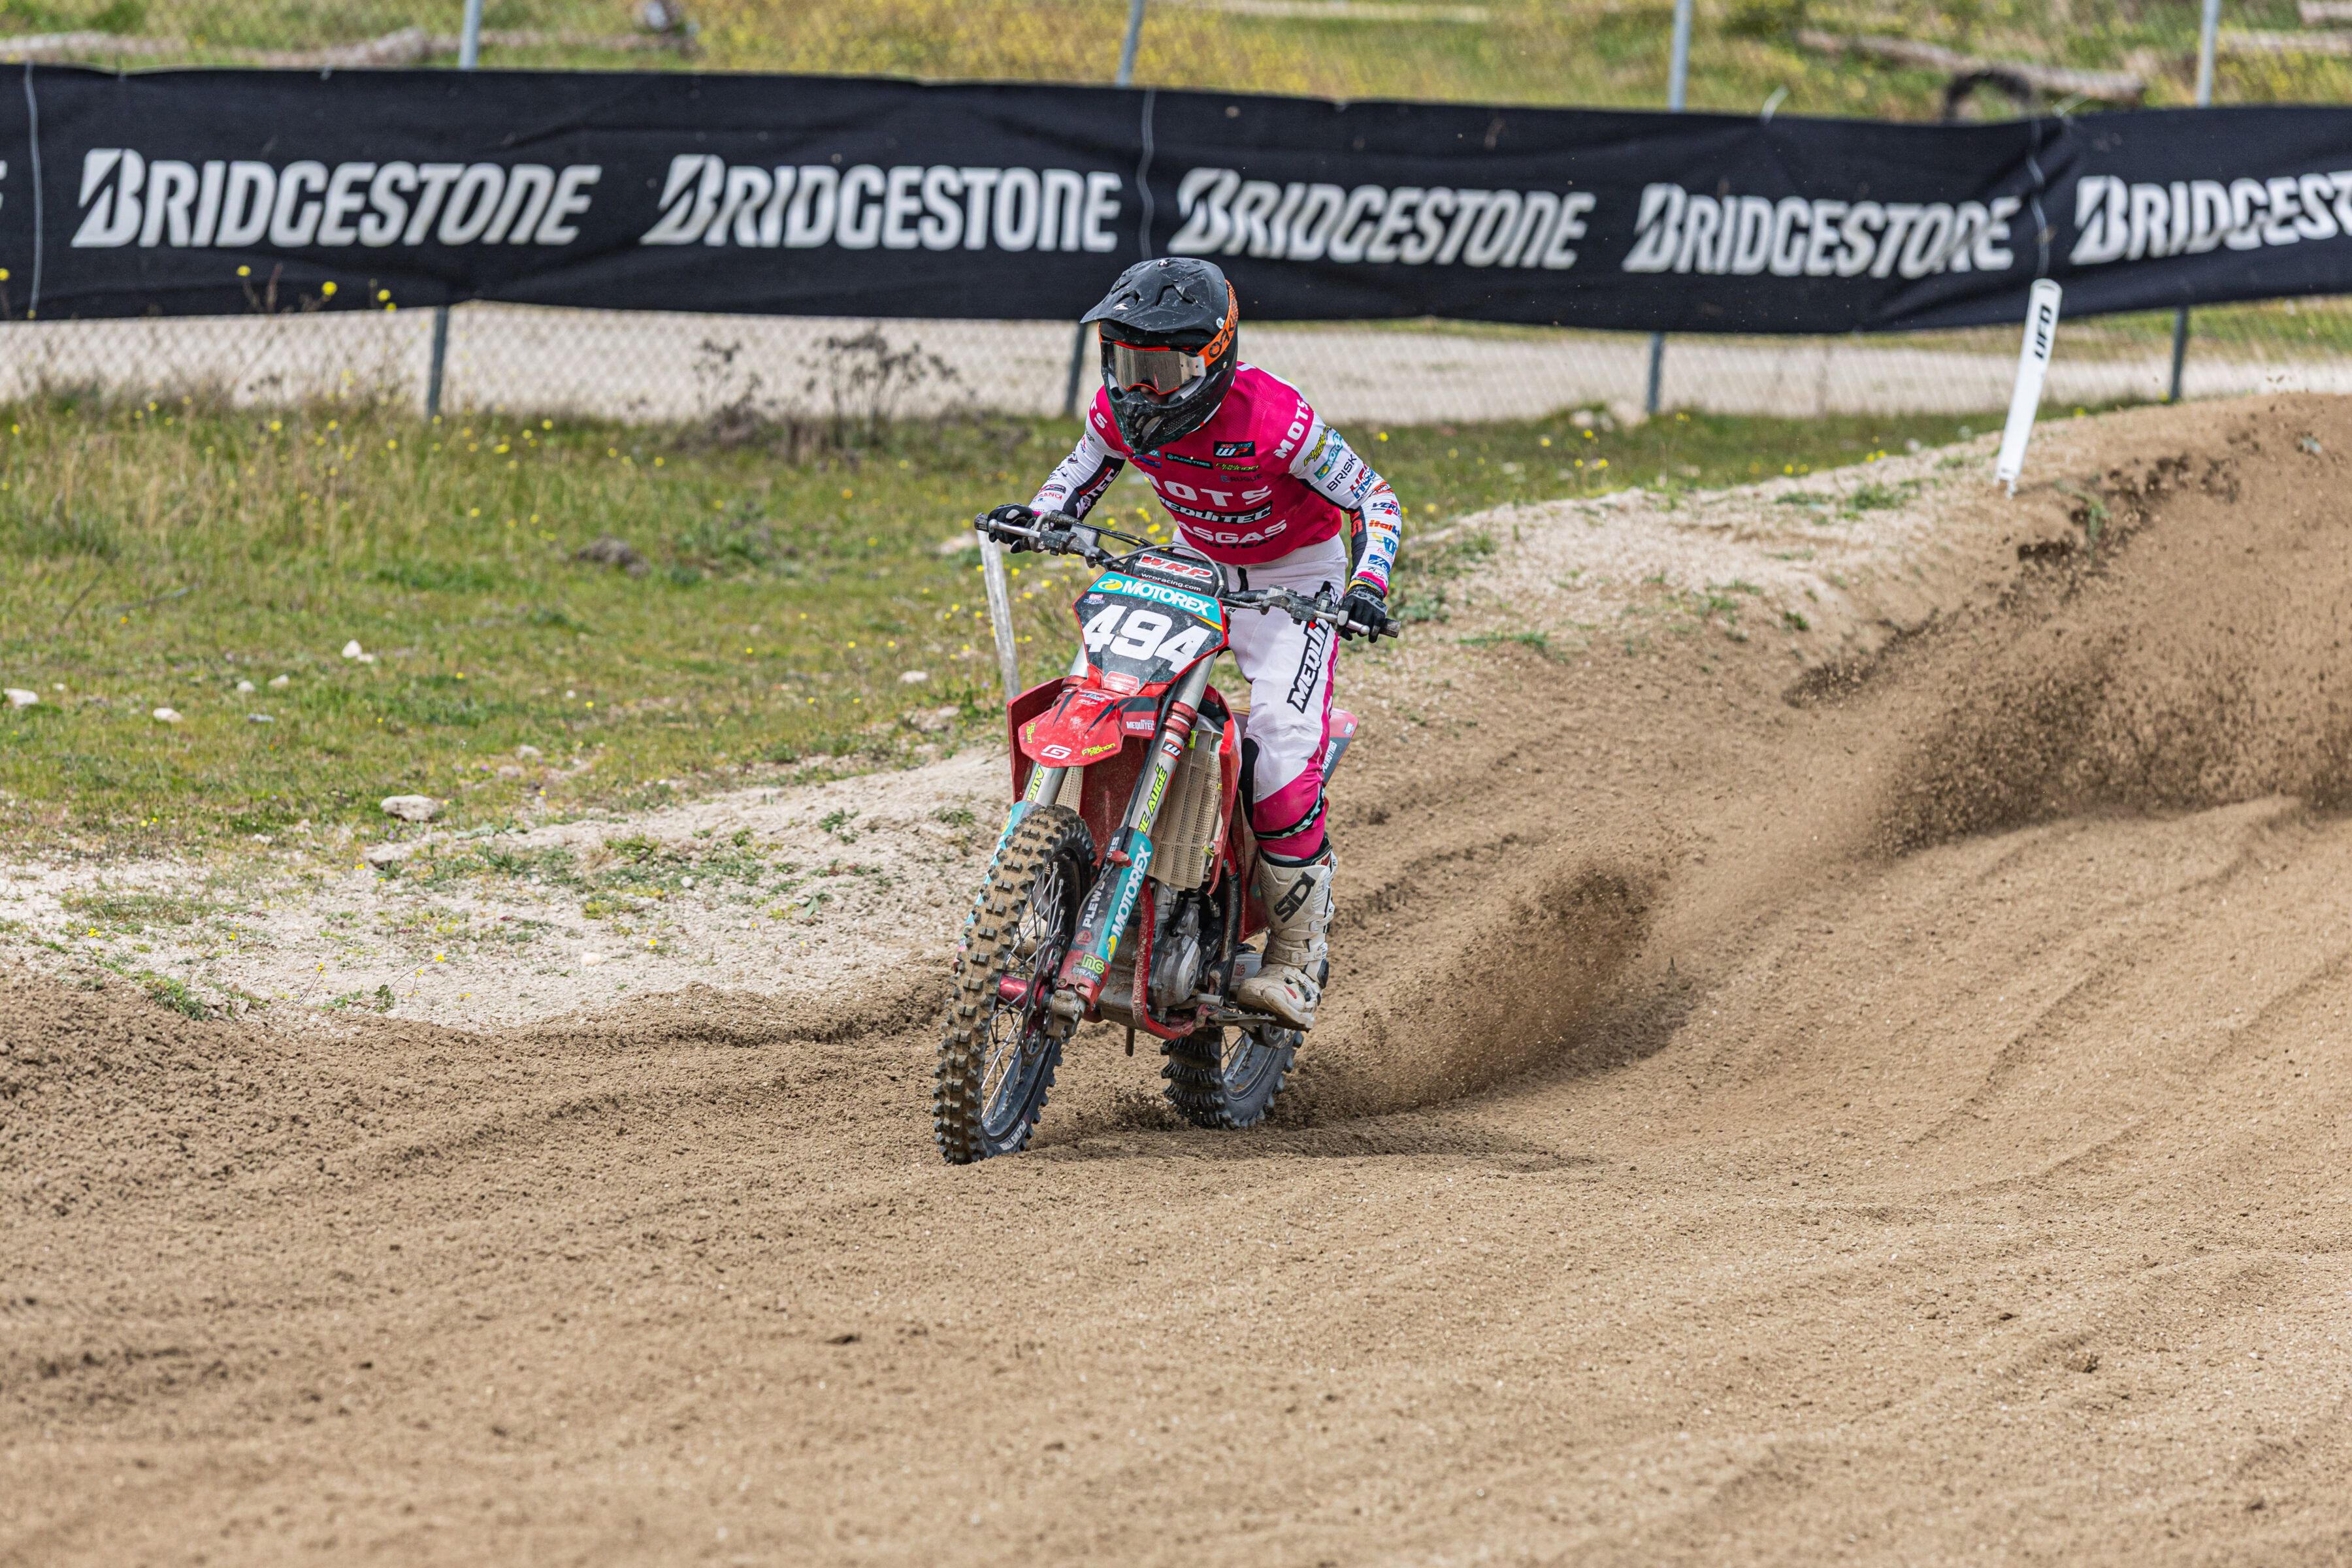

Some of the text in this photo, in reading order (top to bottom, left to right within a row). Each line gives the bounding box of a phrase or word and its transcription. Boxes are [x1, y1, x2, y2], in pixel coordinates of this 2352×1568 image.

[71, 148, 602, 248] BRIDGESTONE
[638, 154, 1123, 252] BRIDGESTONE
[1167, 167, 1596, 270] BRIDGESTONE
[1621, 182, 2021, 279] BRIDGESTONE
[2034, 302, 2052, 360] UFO
[1215, 447, 1249, 456] WP
[1274, 399, 1309, 459] MOTS
[1326, 454, 1357, 491] BRISK
[1177, 519, 1286, 543] ASGAS
[1138, 554, 1213, 578] WRP
[1141, 573, 1201, 592] wrpracing.com
[1122, 580, 1211, 616] MOTOREX
[1083, 604, 1211, 674] 494
[1126, 720, 1154, 730] MEQUITEC
[1111, 845, 1151, 937] MOTOREX
[1072, 968, 1102, 987] BRAKES
